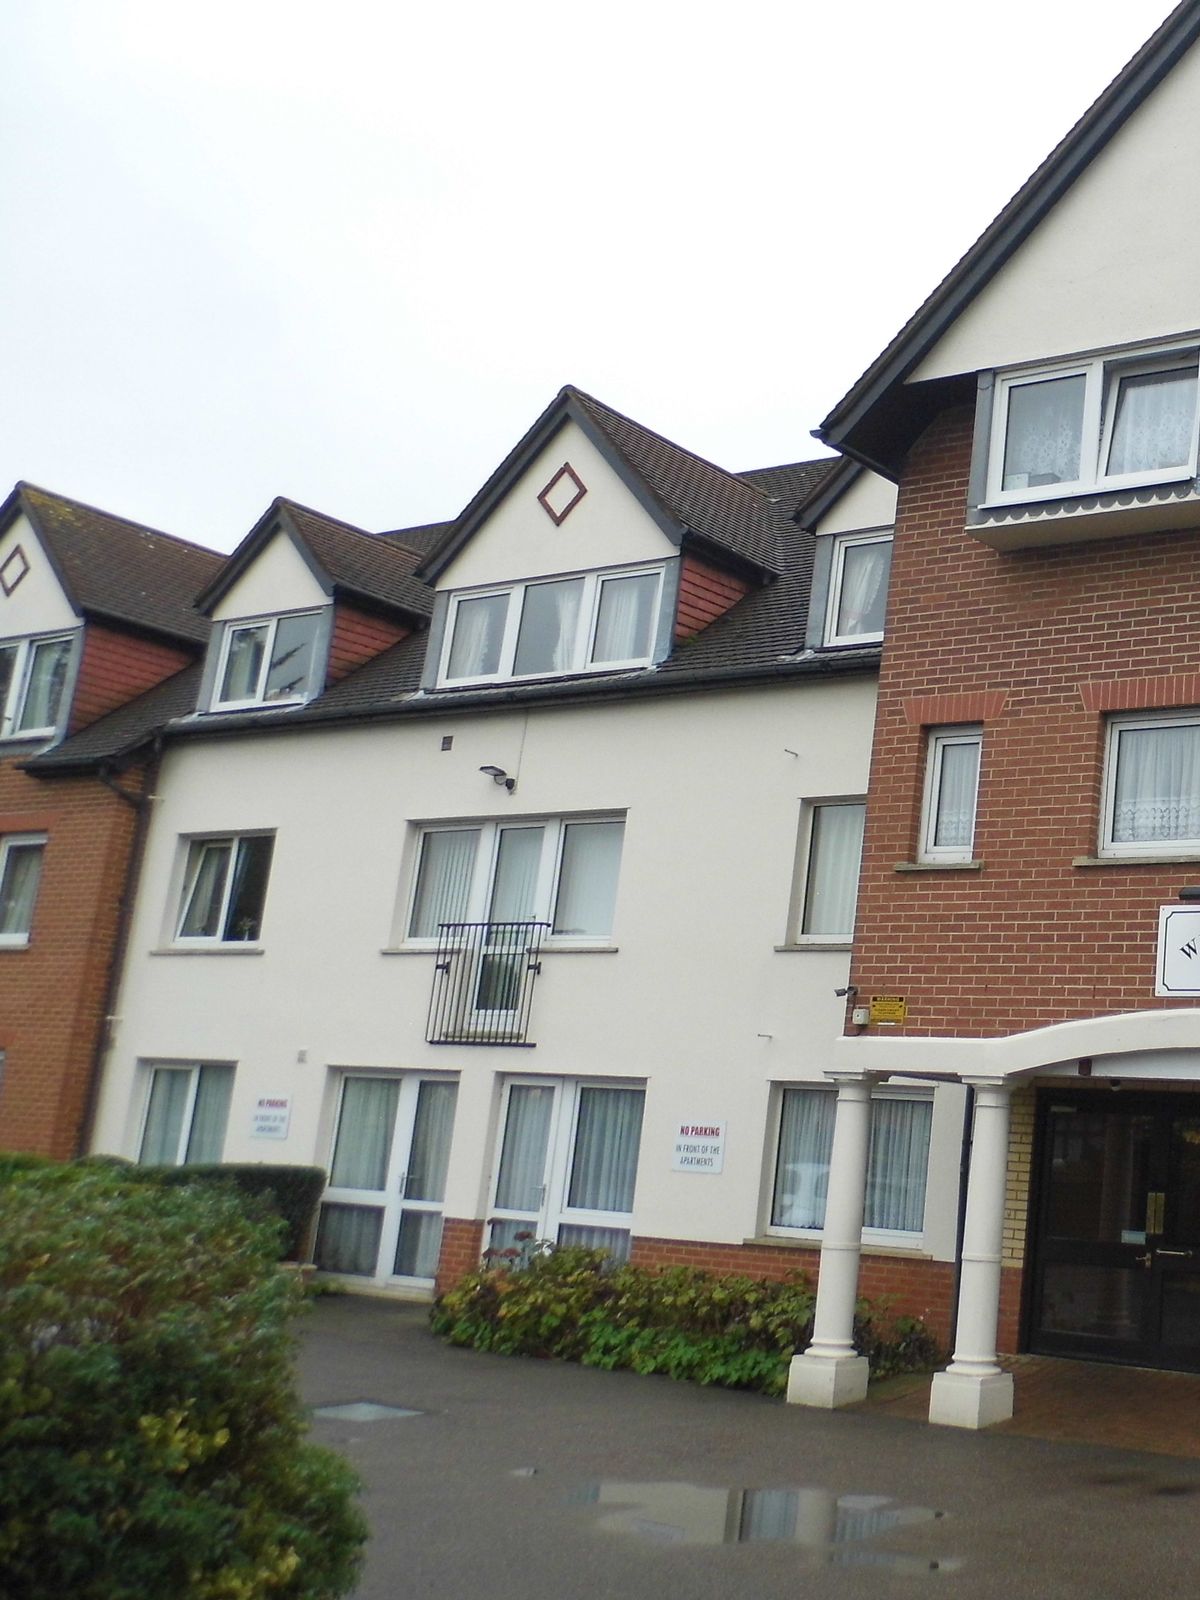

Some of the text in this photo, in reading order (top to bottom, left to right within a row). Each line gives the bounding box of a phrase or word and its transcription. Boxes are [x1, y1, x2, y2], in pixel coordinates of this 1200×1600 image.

[680, 1125, 720, 1137] NO PARKING
[682, 1144, 700, 1154] FRONT
[701, 1144, 709, 1154] OF
[710, 1145, 720, 1155] THE
[680, 1156, 714, 1167] APARTMENTS
